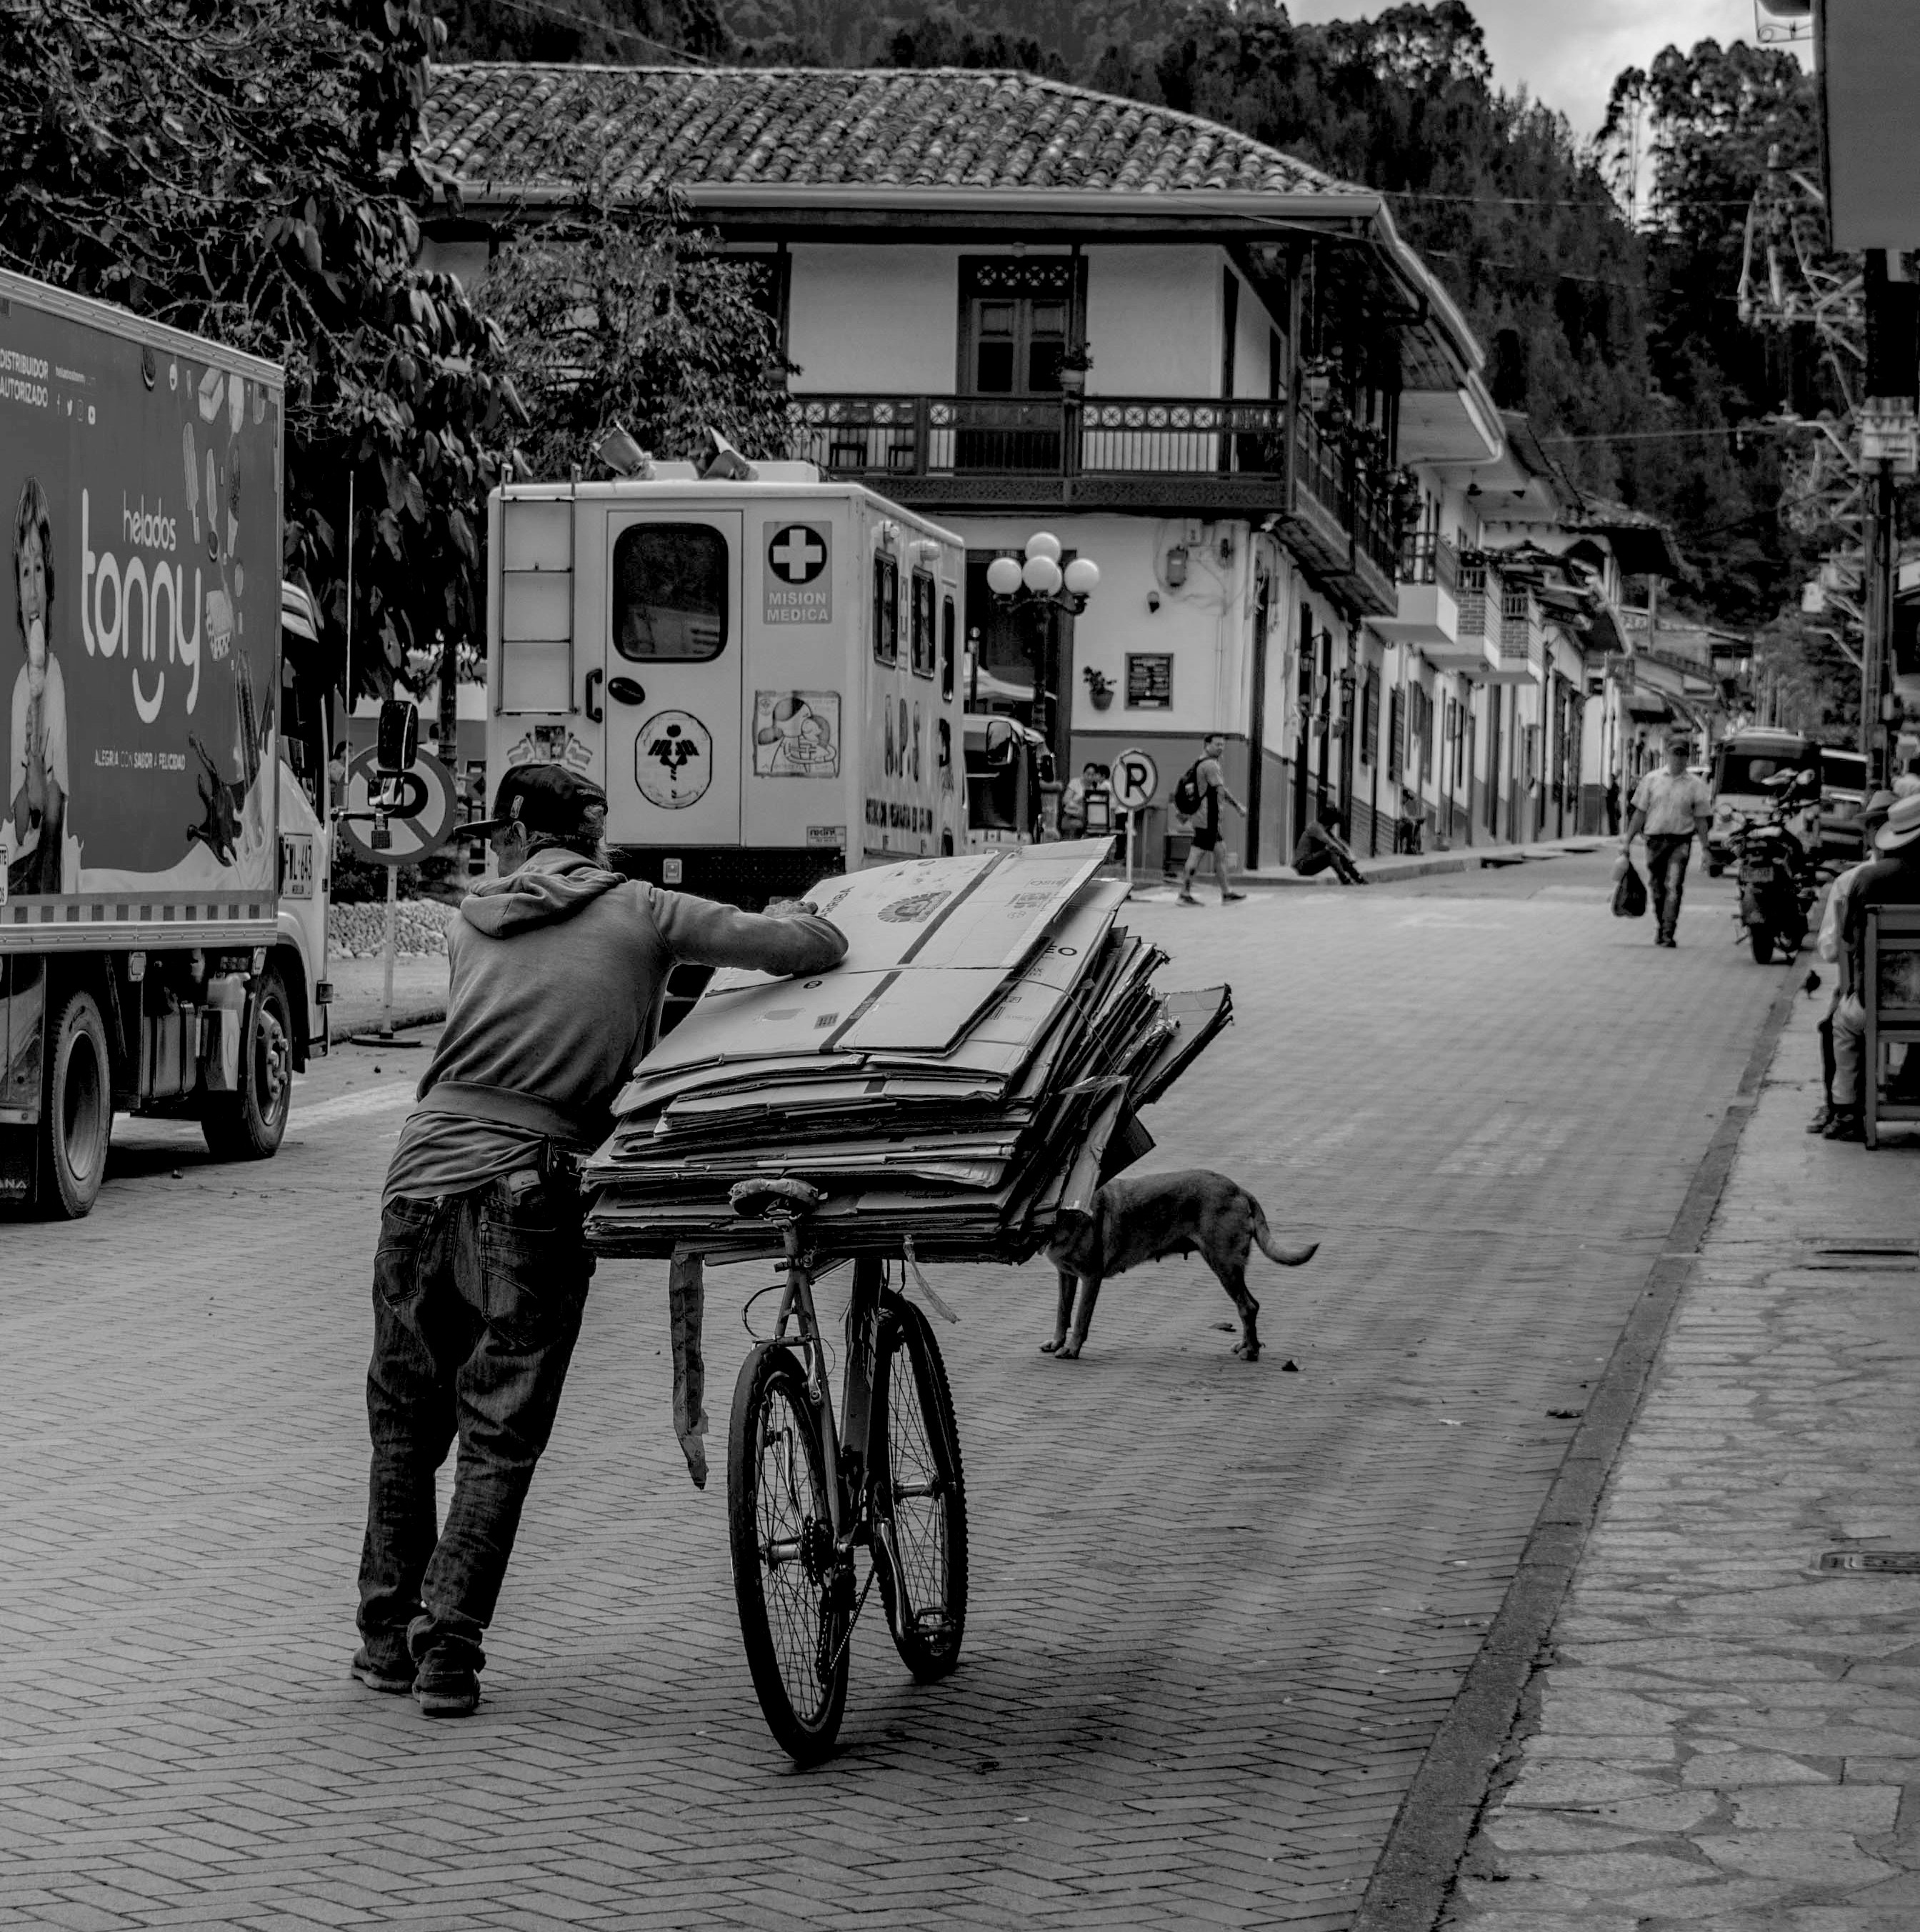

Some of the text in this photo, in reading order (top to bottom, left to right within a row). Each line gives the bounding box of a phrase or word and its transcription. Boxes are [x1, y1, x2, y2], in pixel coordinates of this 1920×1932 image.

[0, 348, 49, 381] DISTRIBUIDOR
[0, 376, 48, 408] AUTORIZADO
[123, 489, 176, 551] helados
[81, 488, 201, 715] tonny
[769, 591, 826, 605] MISION
[766, 609, 829, 621] MEDICA
